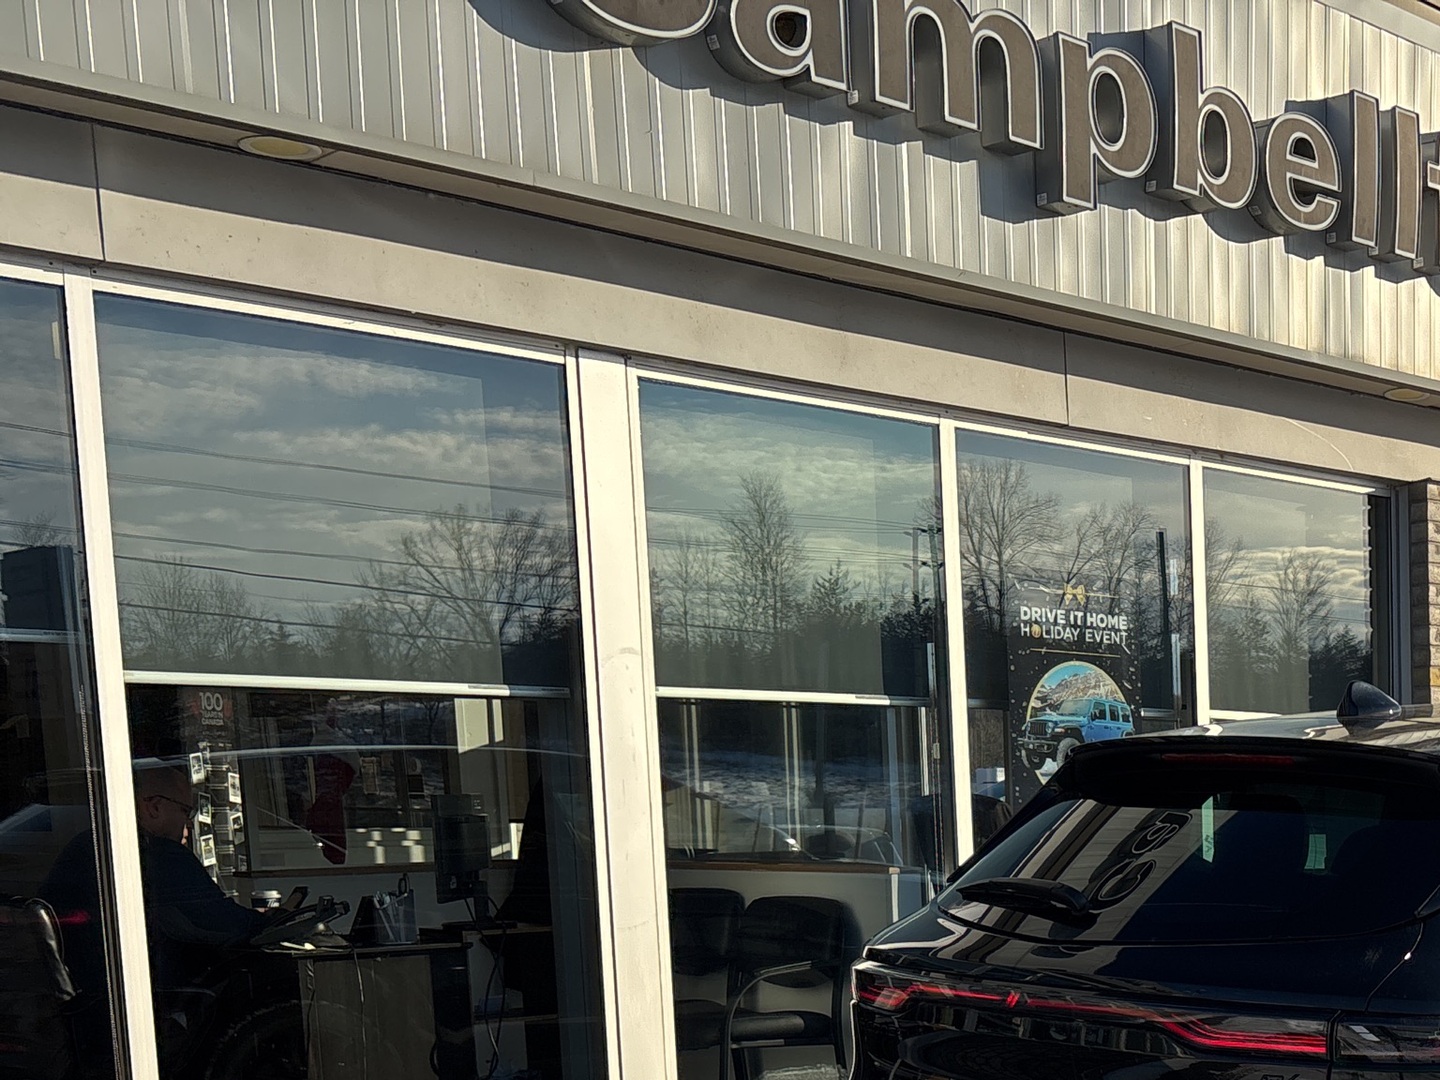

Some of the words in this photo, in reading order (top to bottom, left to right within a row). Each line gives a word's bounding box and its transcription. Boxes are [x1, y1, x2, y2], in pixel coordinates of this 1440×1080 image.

[1020, 605, 1066, 624] DRIVE
[1070, 610, 1084, 626] IT
[1087, 612, 1128, 630] HOME
[1020, 622, 1080, 641] HOLIDAY
[1085, 628, 1128, 644] EVENT
[199, 691, 223, 711] 100
